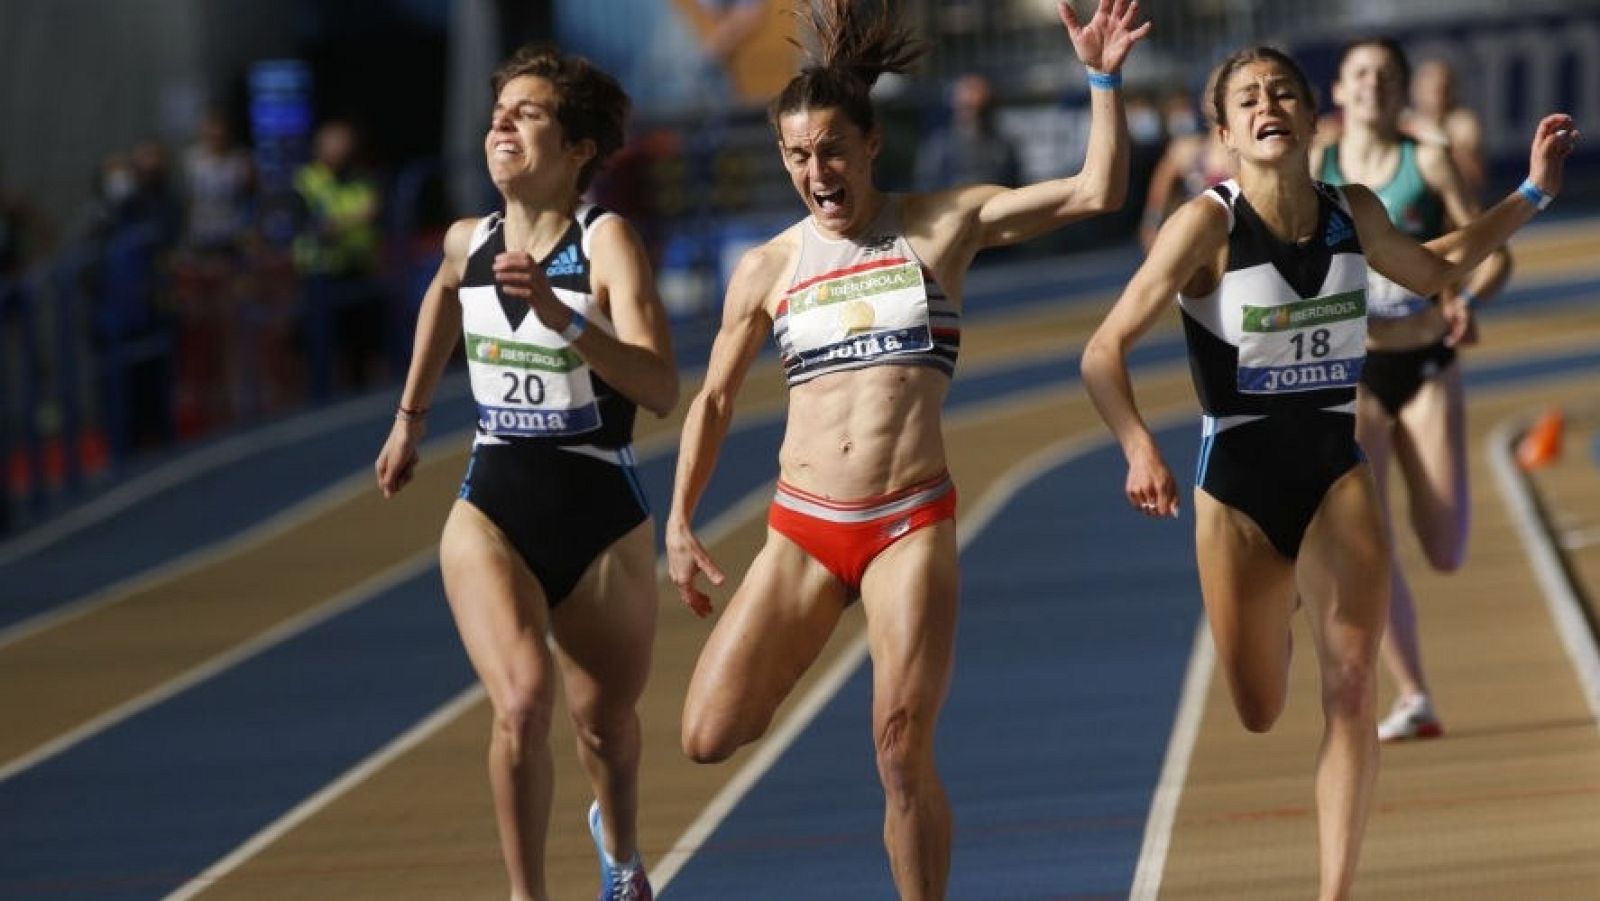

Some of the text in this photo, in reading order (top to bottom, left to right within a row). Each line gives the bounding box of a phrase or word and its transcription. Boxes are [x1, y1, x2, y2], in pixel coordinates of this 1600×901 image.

[546, 263, 584, 277] adidas
[831, 274, 903, 296] IBERDROLA
[1290, 329, 1331, 361] 18
[502, 371, 545, 405] 20
[1264, 363, 1345, 389] Joma
